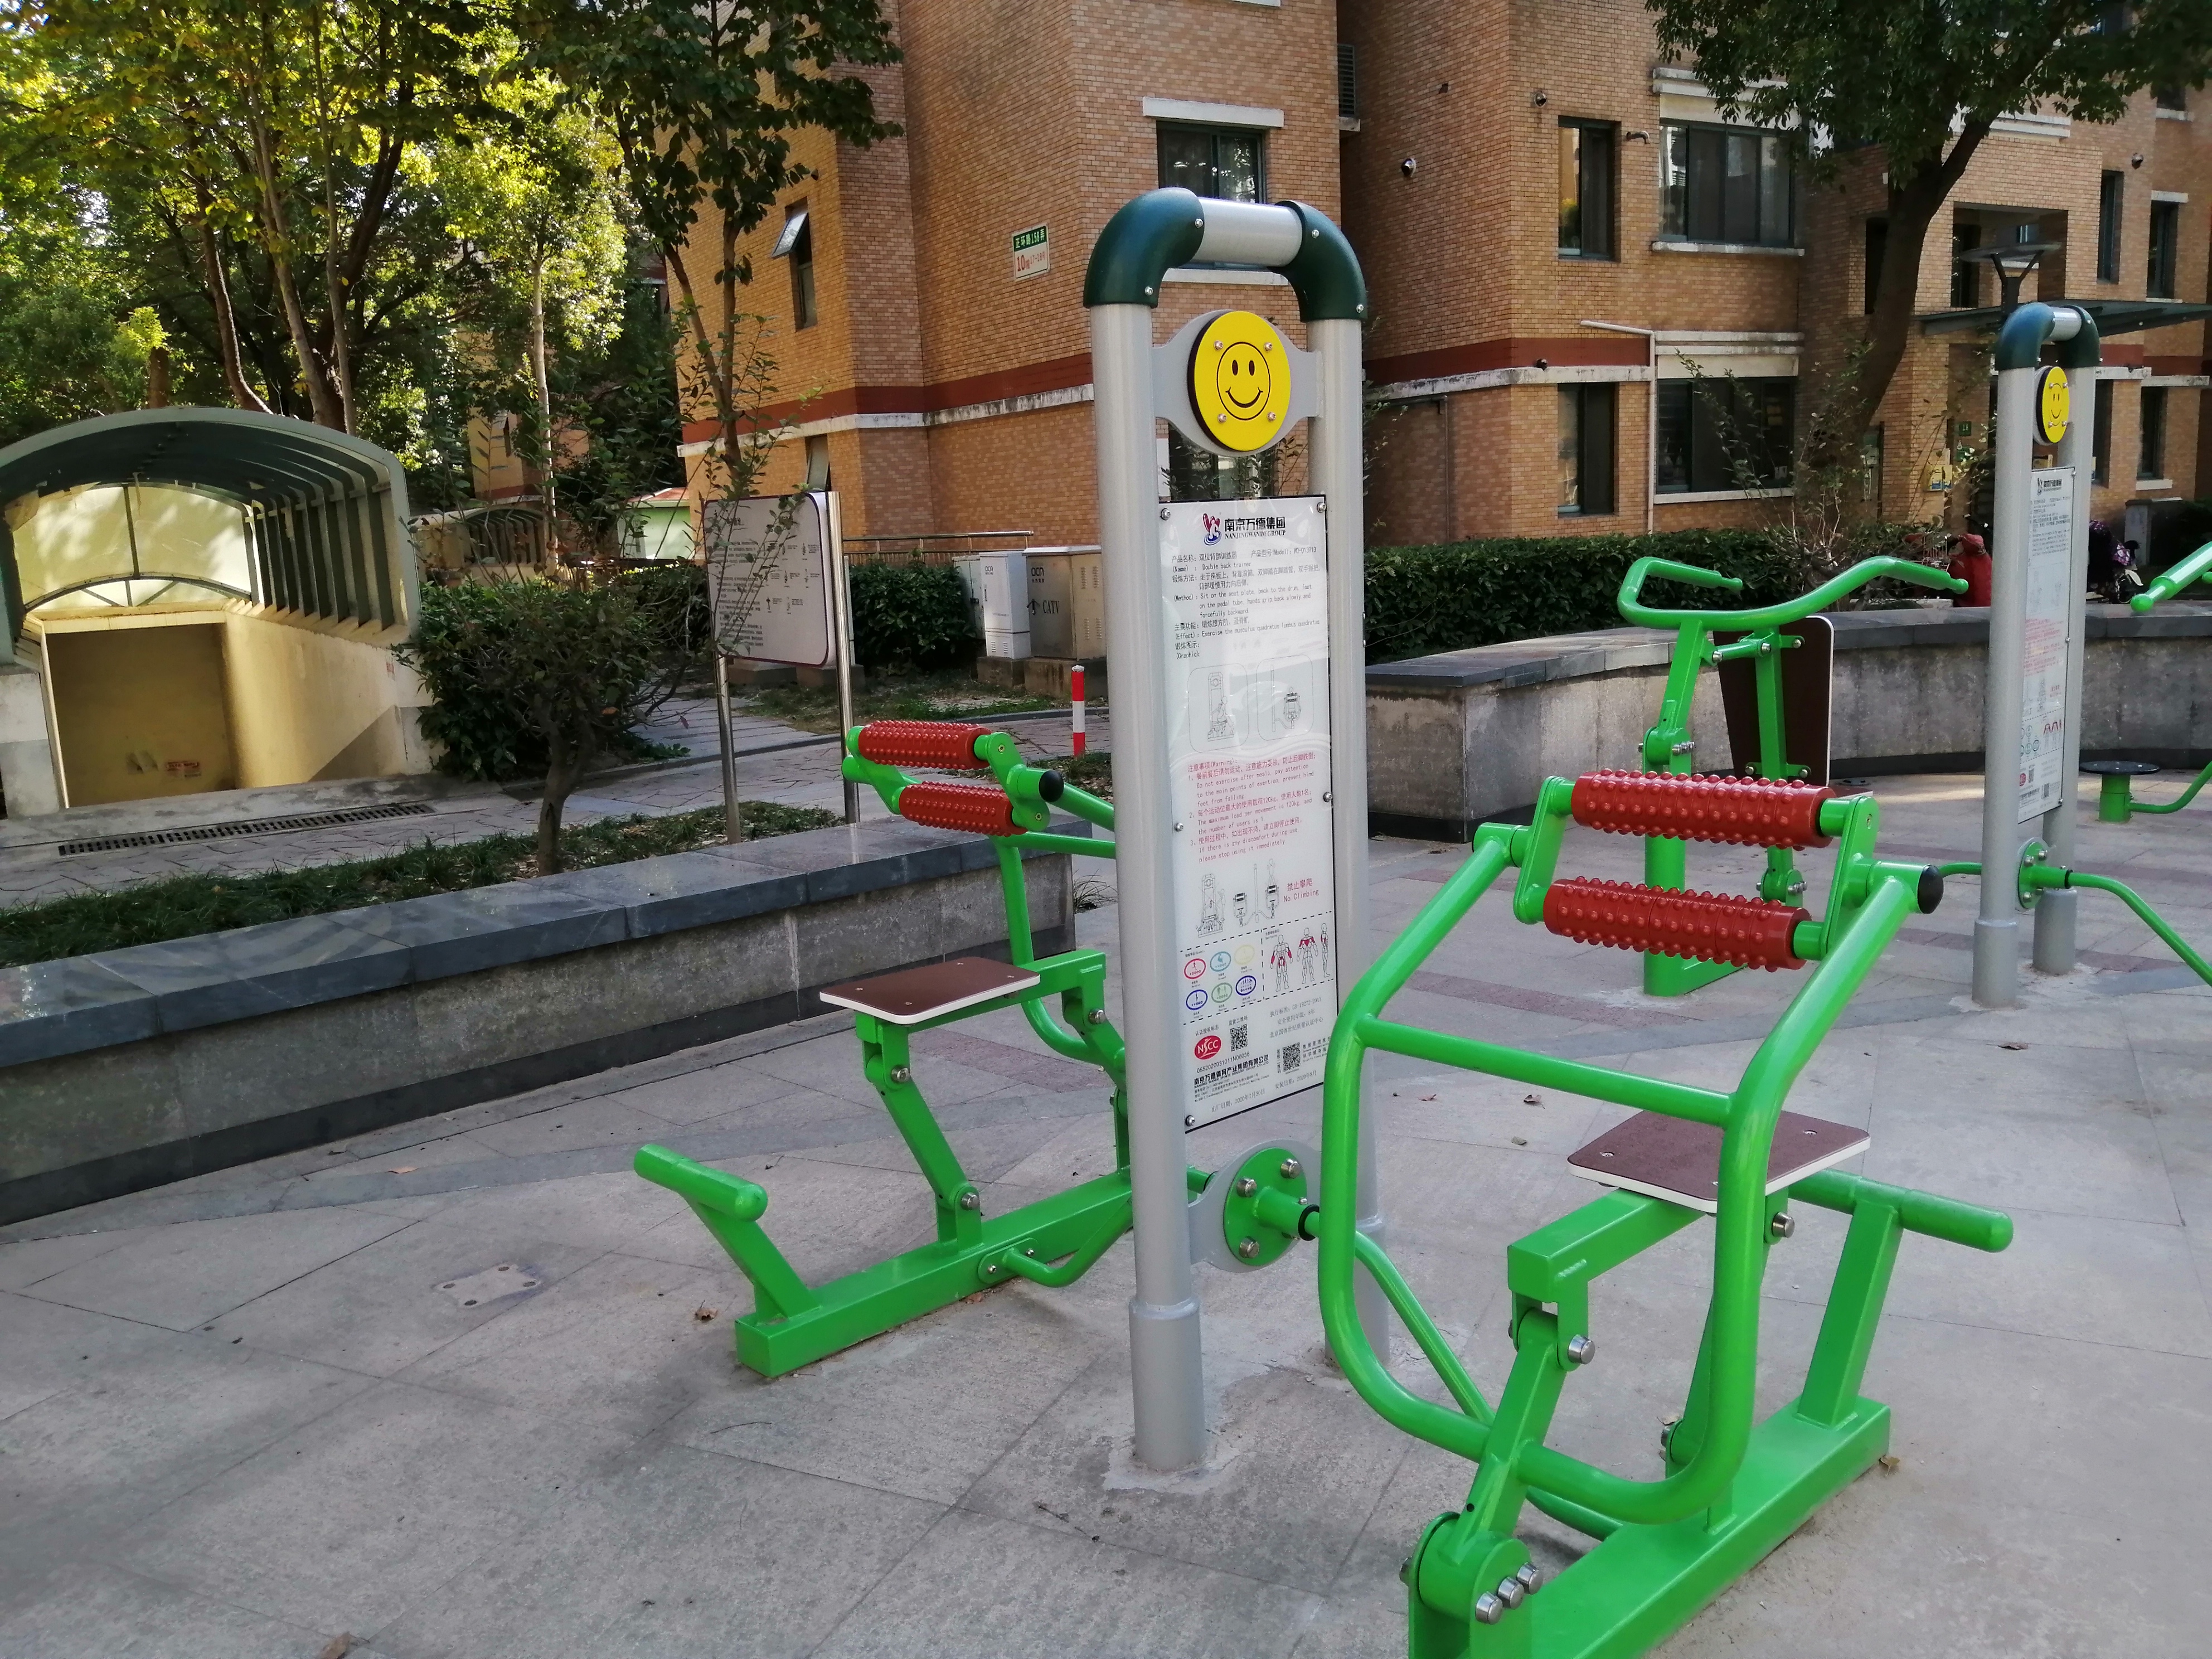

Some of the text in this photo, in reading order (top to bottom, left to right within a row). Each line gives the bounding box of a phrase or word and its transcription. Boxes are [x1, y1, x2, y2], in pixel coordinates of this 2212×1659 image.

[1224, 516, 1286, 532] 南京万德集团
[1043, 600, 1060, 614] CATV
[1285, 764, 1309, 772] attention
[1255, 806, 1276, 814] movement
[1243, 834, 1269, 843] discomfort
[1199, 855, 1216, 864] please
[1287, 878, 1313, 891] 禁止攀爬
[1293, 890, 1319, 900] Climbing
[1197, 1037, 1219, 1054] NSCC
